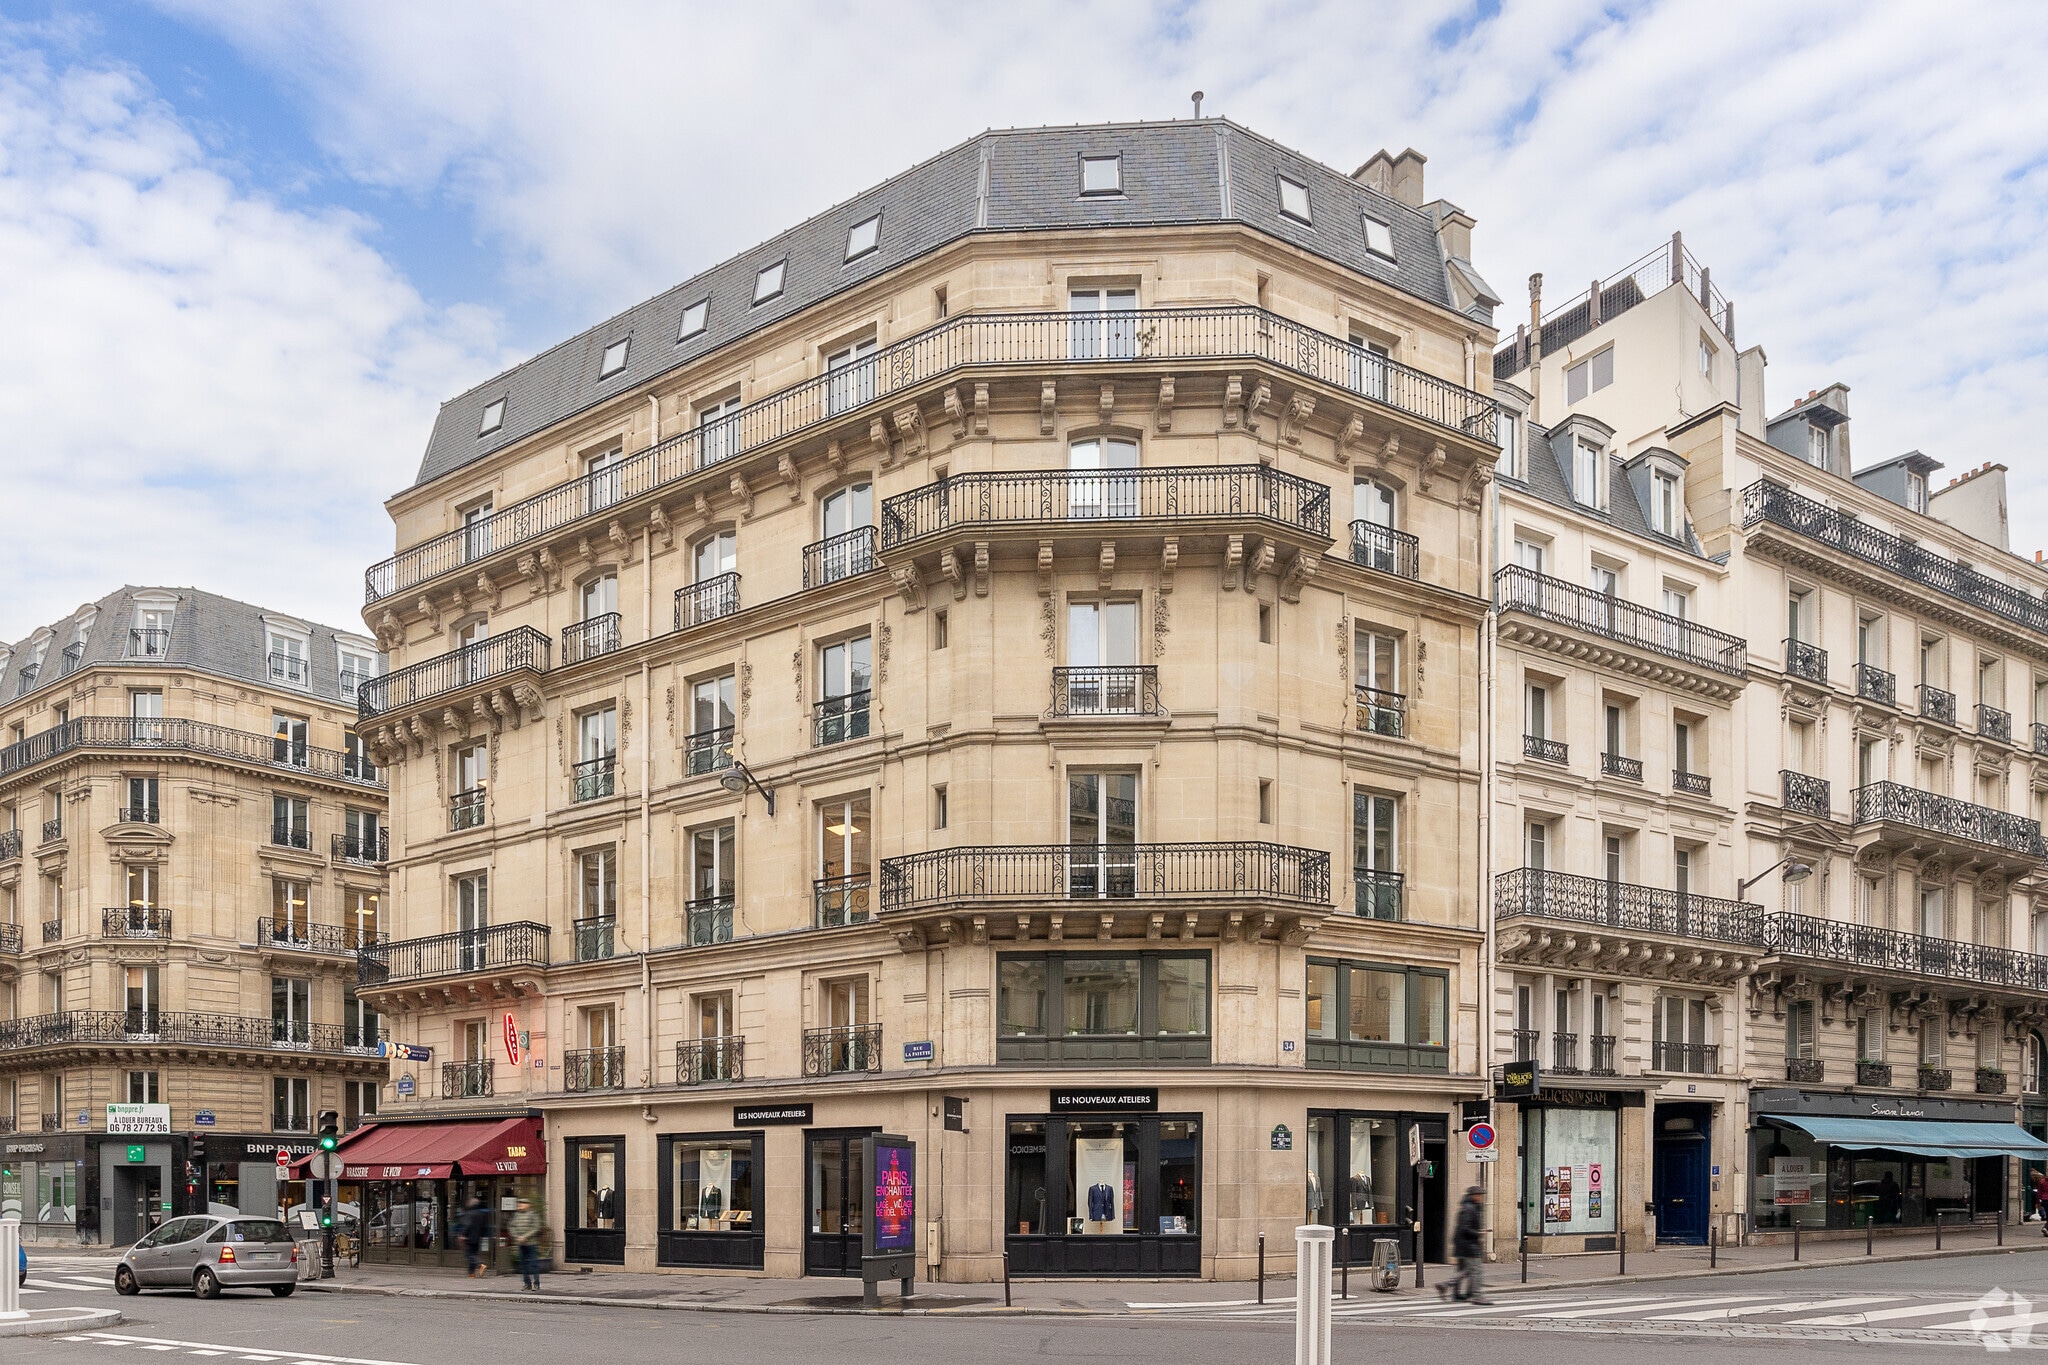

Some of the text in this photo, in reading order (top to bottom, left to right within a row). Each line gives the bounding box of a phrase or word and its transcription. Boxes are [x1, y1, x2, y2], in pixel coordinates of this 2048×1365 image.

[509, 1023, 517, 1054] TABAC
[1058, 1096, 1151, 1104] LES NOUVEAUX ATELIERS
[1585, 1091, 1607, 1105] SIAM
[117, 1105, 144, 1114] bnppre.fr
[1871, 1103, 1924, 1117] Simone Lemon
[748, 1111, 780, 1119] NOUVEAUX
[781, 1110, 806, 1118] ATELIERS
[110, 1124, 168, 1132] 06 78 27 72 96
[6, 1144, 43, 1153] BNP PARIBAS
[246, 1144, 275, 1153] BNP
[507, 1146, 527, 1157] TABAC
[496, 1162, 518, 1171] LE VIZIR
[346, 1166, 369, 1177] BRASSERIE
[382, 1167, 390, 1177] LE
[881, 1171, 907, 1185] PARIS
